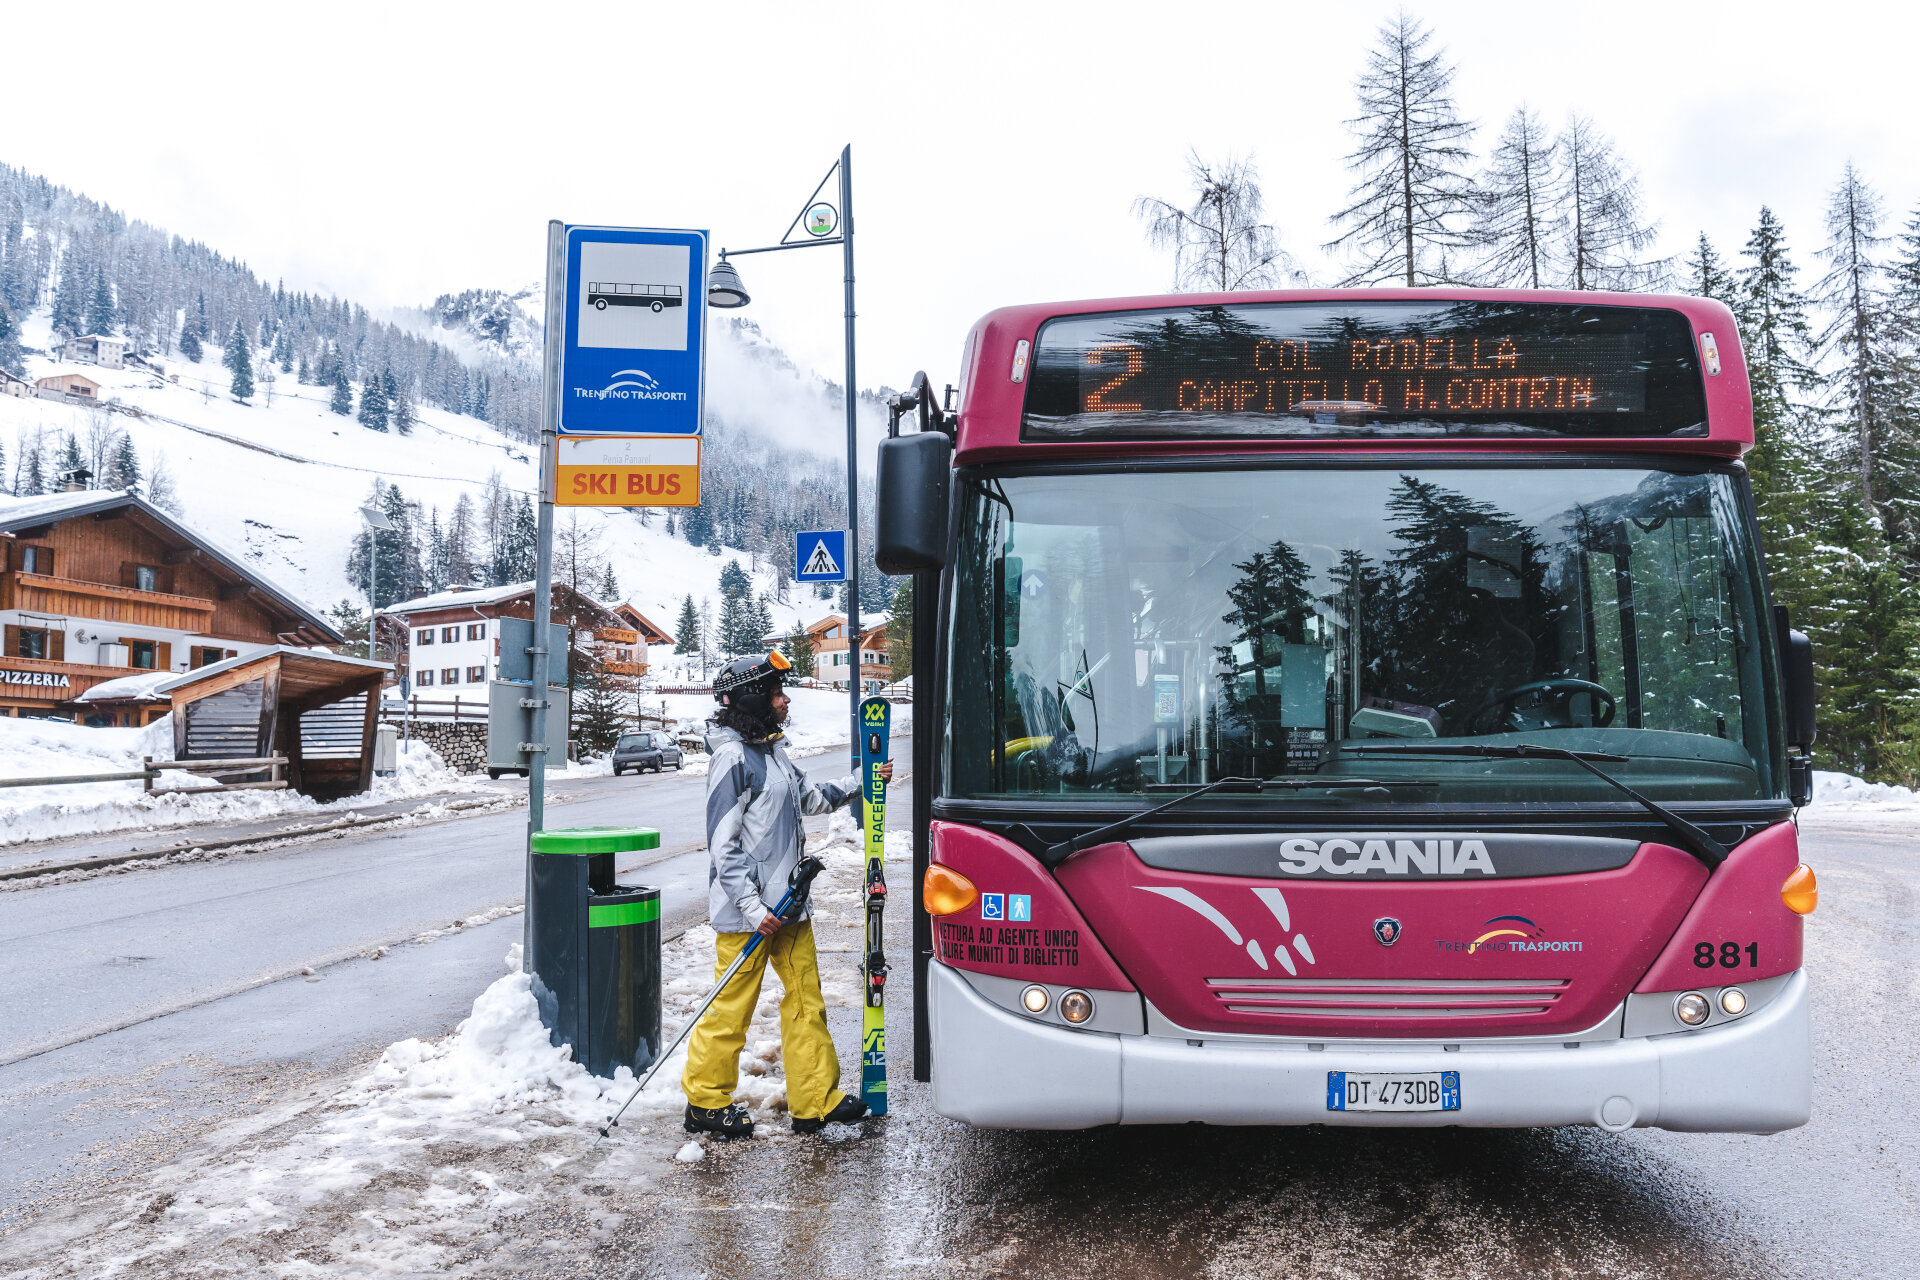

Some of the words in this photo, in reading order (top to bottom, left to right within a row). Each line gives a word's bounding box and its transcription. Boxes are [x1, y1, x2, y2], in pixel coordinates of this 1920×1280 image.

[1255, 340, 1321, 371] COL
[1352, 338, 1516, 370] RODELLA
[1086, 342, 1142, 411] 2
[631, 390, 687, 401] TRASPORTI
[1179, 380, 1382, 411] CAMPITELLO
[625, 441, 632, 451] 2
[572, 472, 617, 496] SKI
[627, 473, 681, 496] BUS
[872, 762, 884, 843] RACETIGER
[1278, 839, 1497, 875] SCANIA
[979, 927, 993, 945] AD
[998, 928, 1040, 947] AGENTE
[1044, 930, 1079, 947] UNICO
[1435, 940, 1507, 952] TRENTINO
[1509, 941, 1583, 952] TRASPORTI
[968, 945, 1003, 963] MUNITI
[1008, 947, 1018, 965] DI
[1023, 948, 1079, 967] BIGLIETTO
[1693, 941, 1758, 969] 881
[1347, 1081, 1371, 1104] DT
[1378, 1080, 1440, 1104] 473DB
